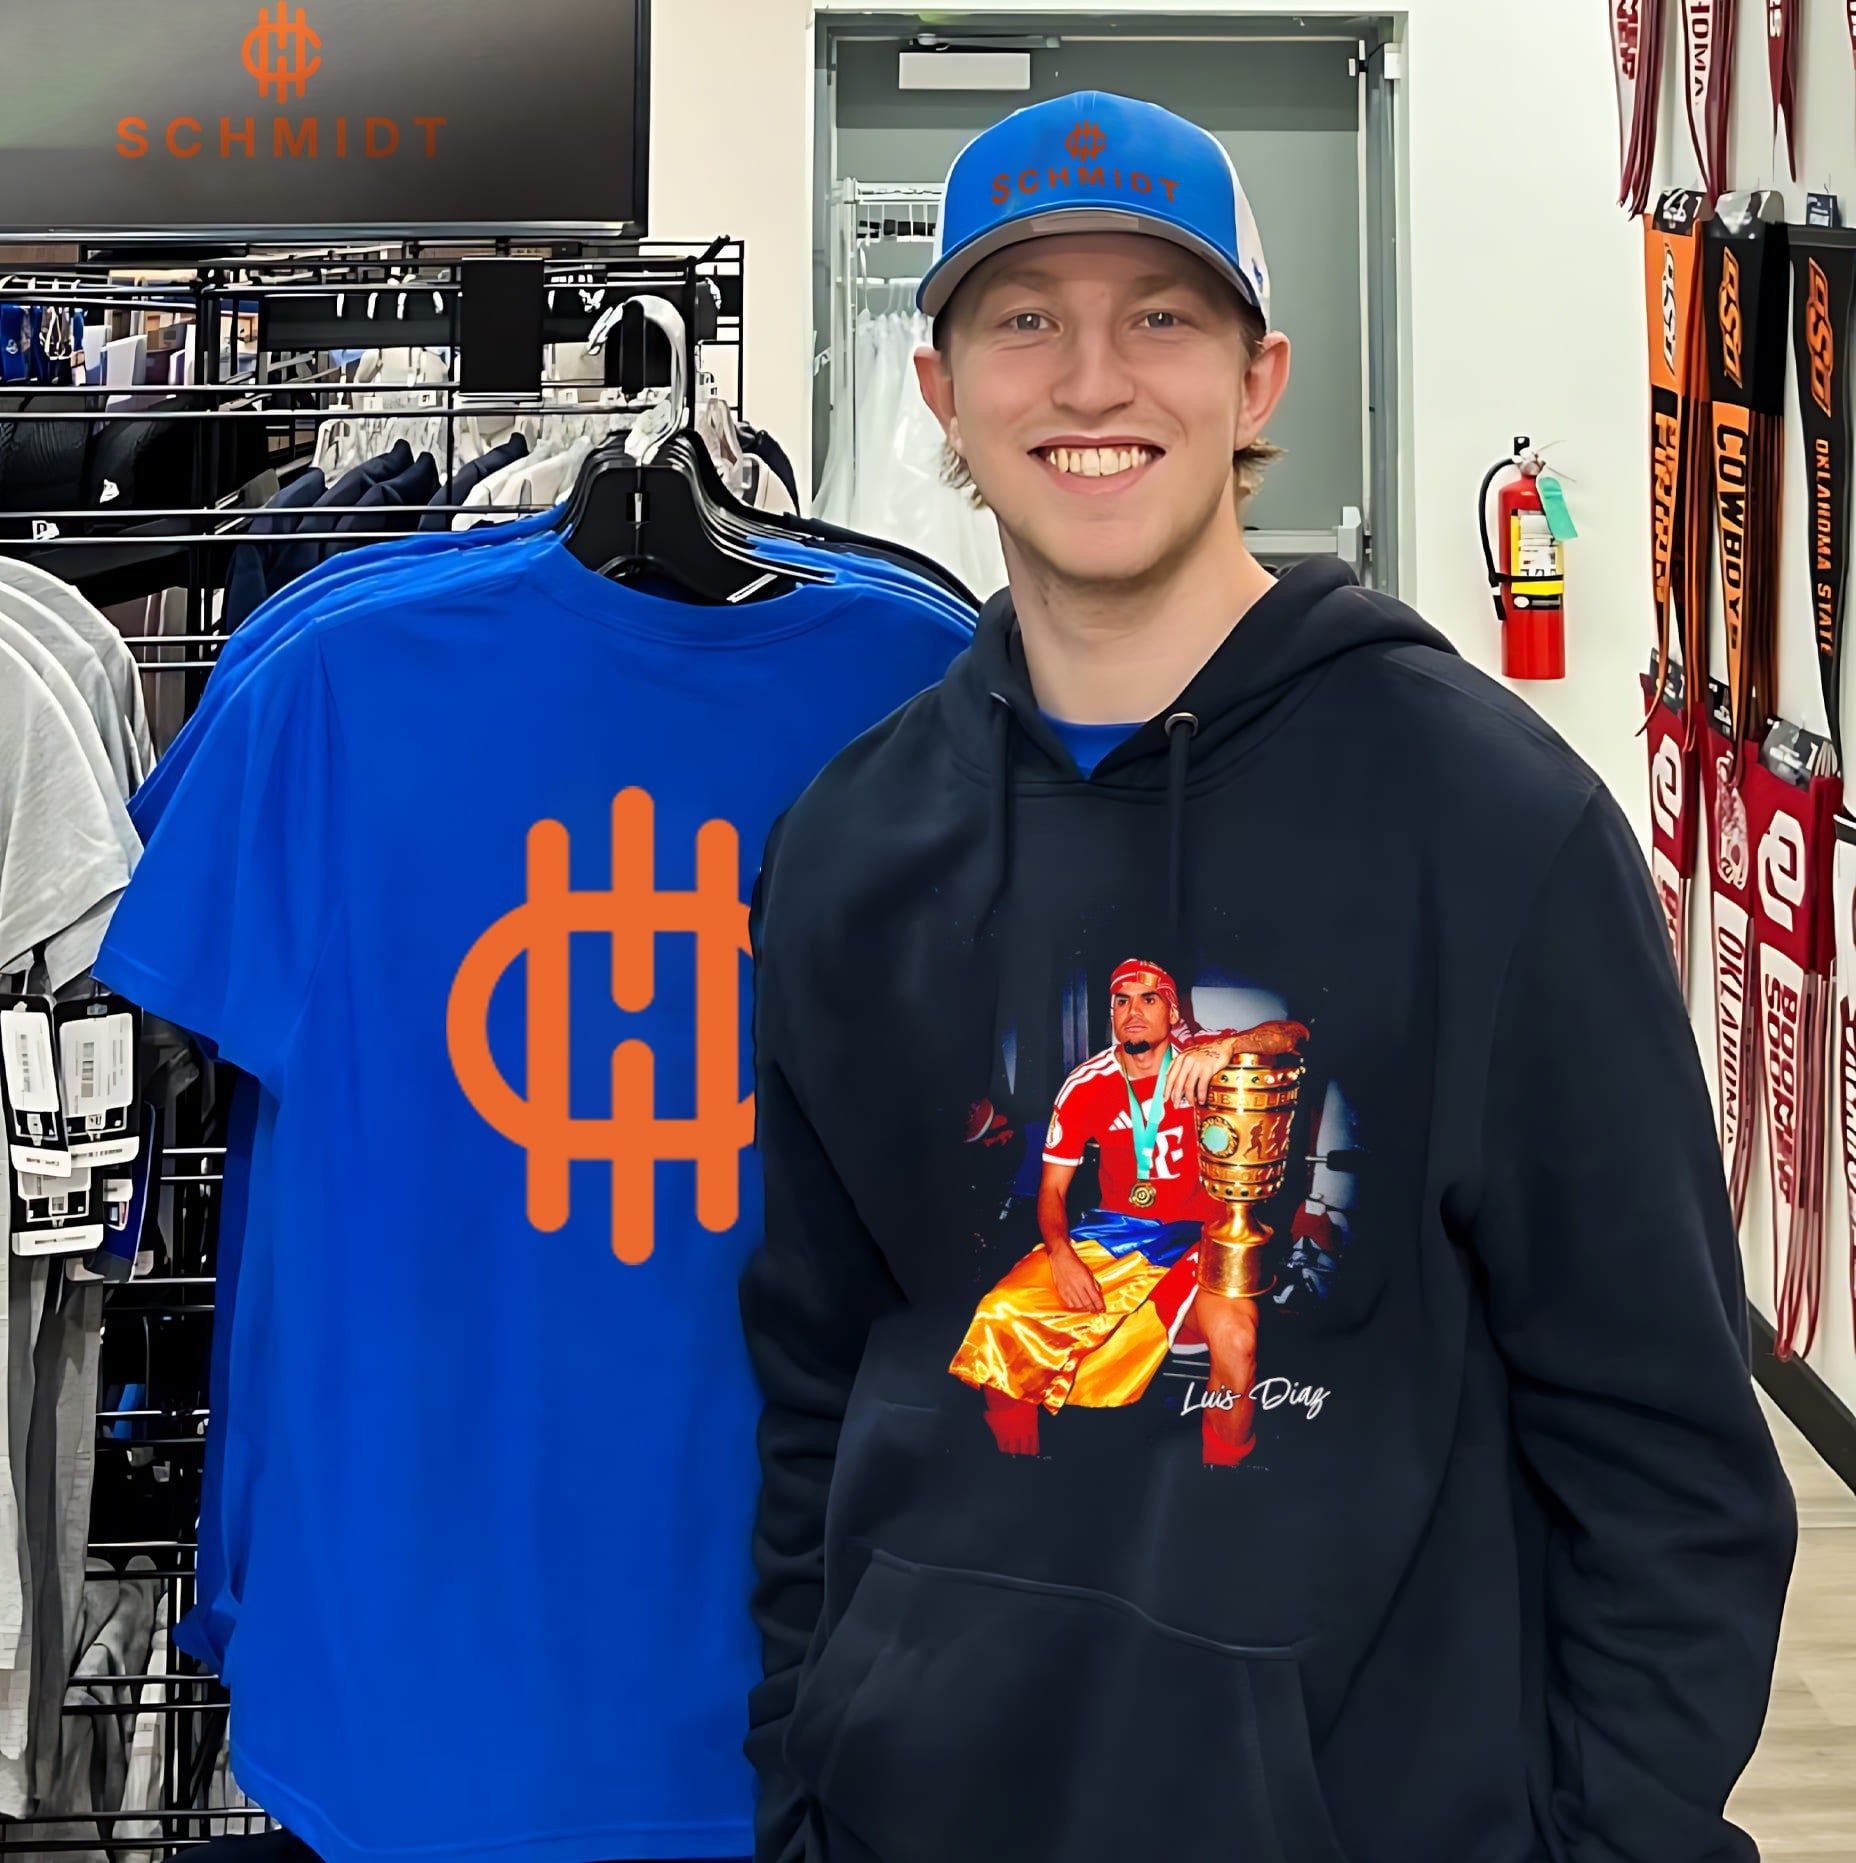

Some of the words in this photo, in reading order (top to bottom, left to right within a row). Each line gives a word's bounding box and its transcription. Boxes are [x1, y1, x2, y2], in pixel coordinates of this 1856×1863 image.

[116, 116, 448, 159] SCHMIDT
[992, 166, 1179, 205] SCHMIDT
[1815, 438, 1832, 570] OKLAHOMA
[1180, 1381, 1242, 1417] Luis
[1248, 1377, 1332, 1420] Diaz
